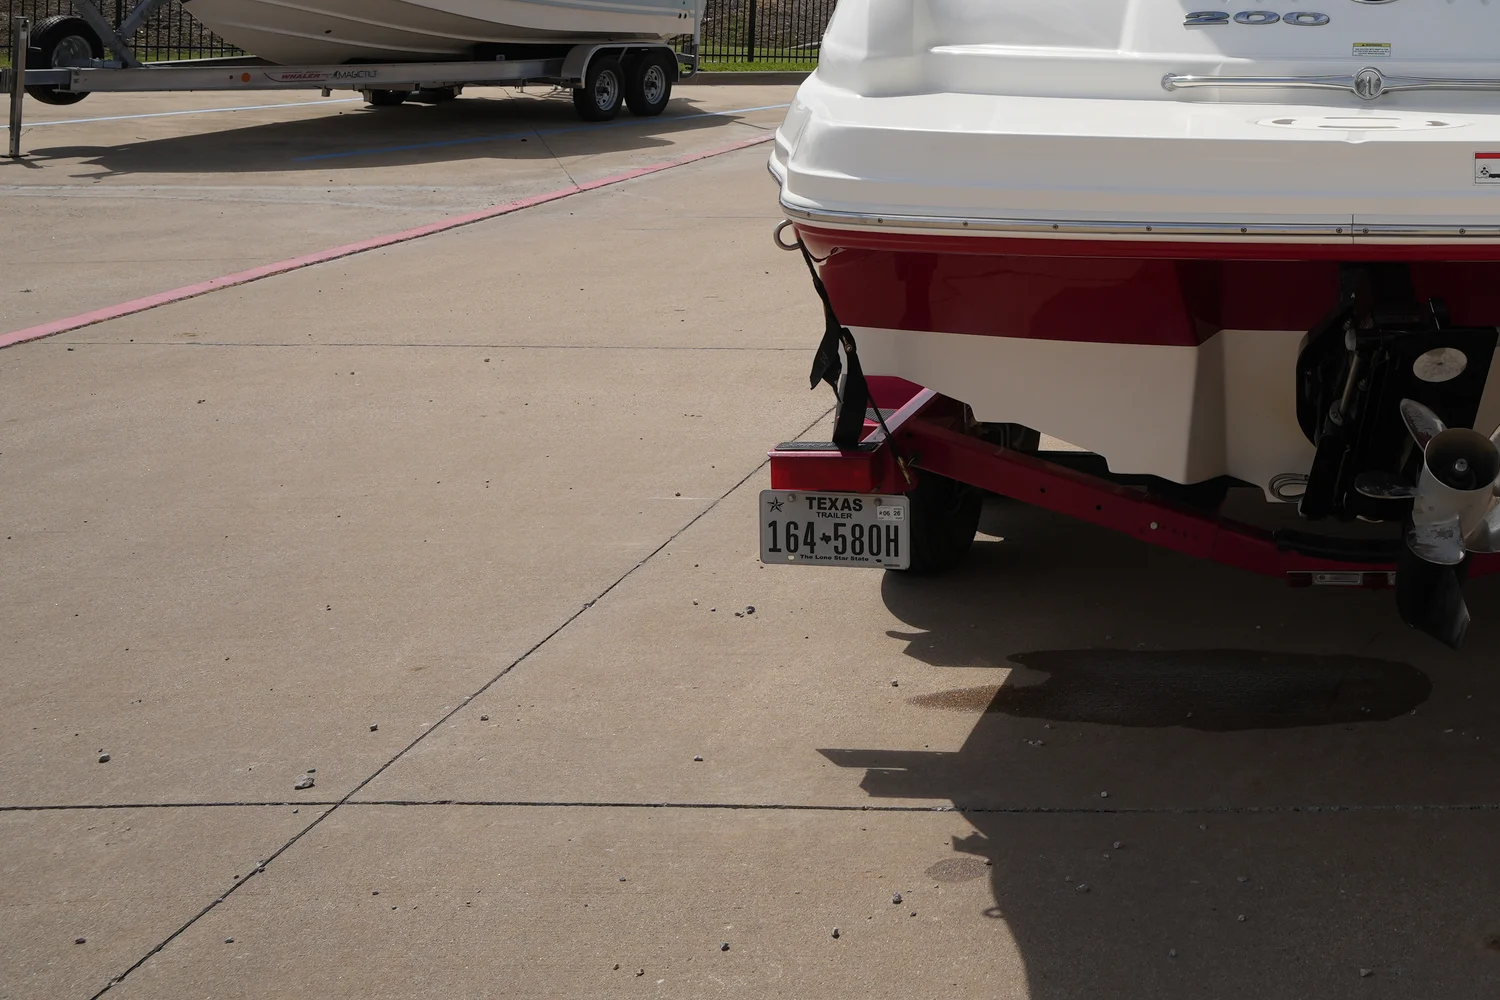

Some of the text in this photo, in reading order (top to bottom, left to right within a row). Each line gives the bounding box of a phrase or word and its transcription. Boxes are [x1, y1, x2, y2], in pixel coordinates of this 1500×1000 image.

[1183, 10, 1331, 26] 200
[805, 496, 863, 512] TEXAS
[816, 511, 852, 519] TRAILER
